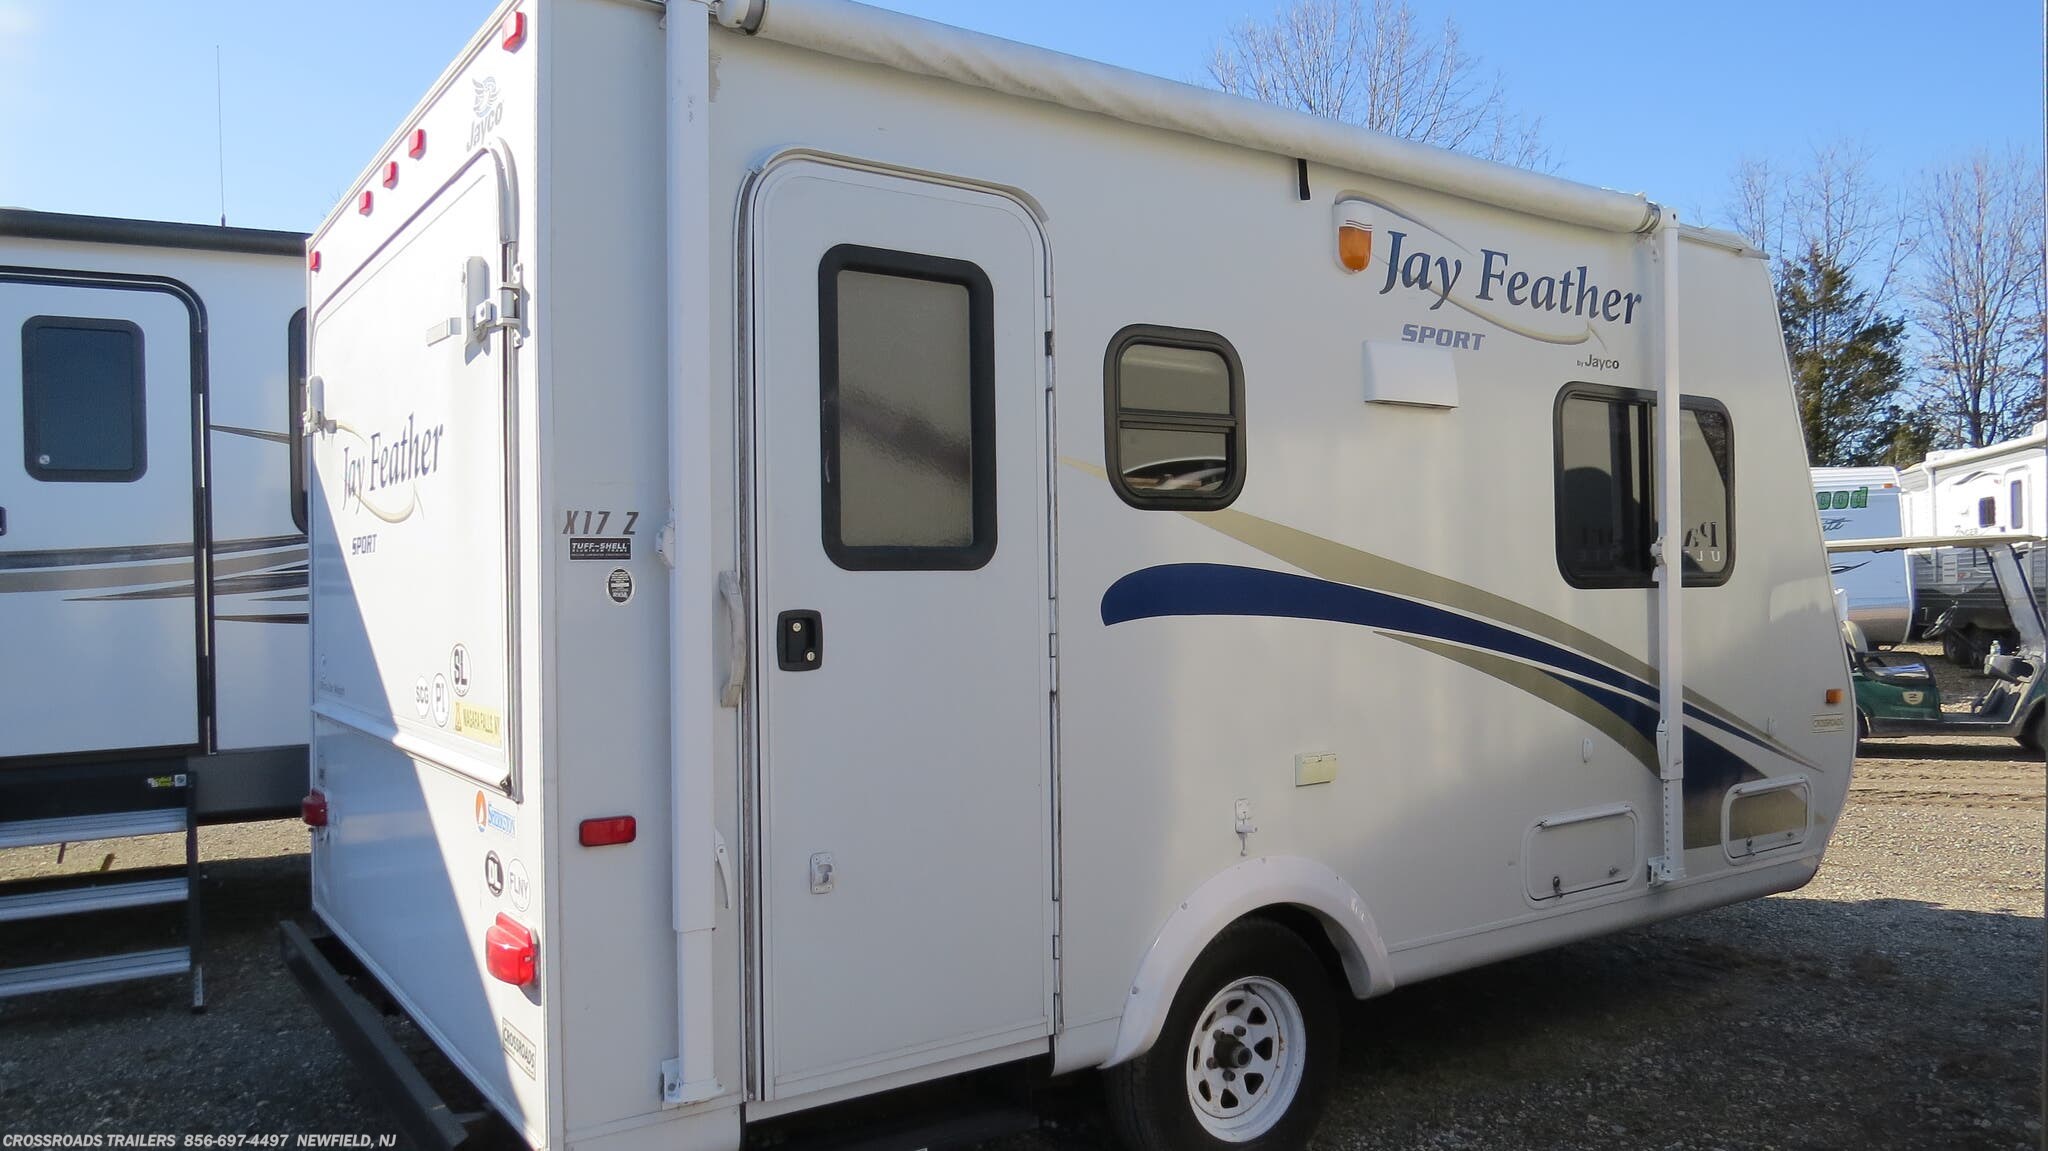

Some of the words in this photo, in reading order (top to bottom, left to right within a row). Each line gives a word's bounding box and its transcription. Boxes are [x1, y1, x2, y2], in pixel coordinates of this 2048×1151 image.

[1379, 230, 1462, 311] Jay
[1474, 248, 1643, 325] Feather
[1401, 323, 1486, 351] SPORT
[1585, 354, 1620, 370] Jayco
[342, 446, 365, 515] Jay
[369, 411, 444, 492] Feather
[562, 510, 611, 535] X17
[622, 511, 639, 535] Z
[351, 533, 378, 556] SPORT
[453, 648, 468, 685] SL
[509, 871, 529, 901] FLNY
[503, 1026, 536, 1069] CROSSROADS
